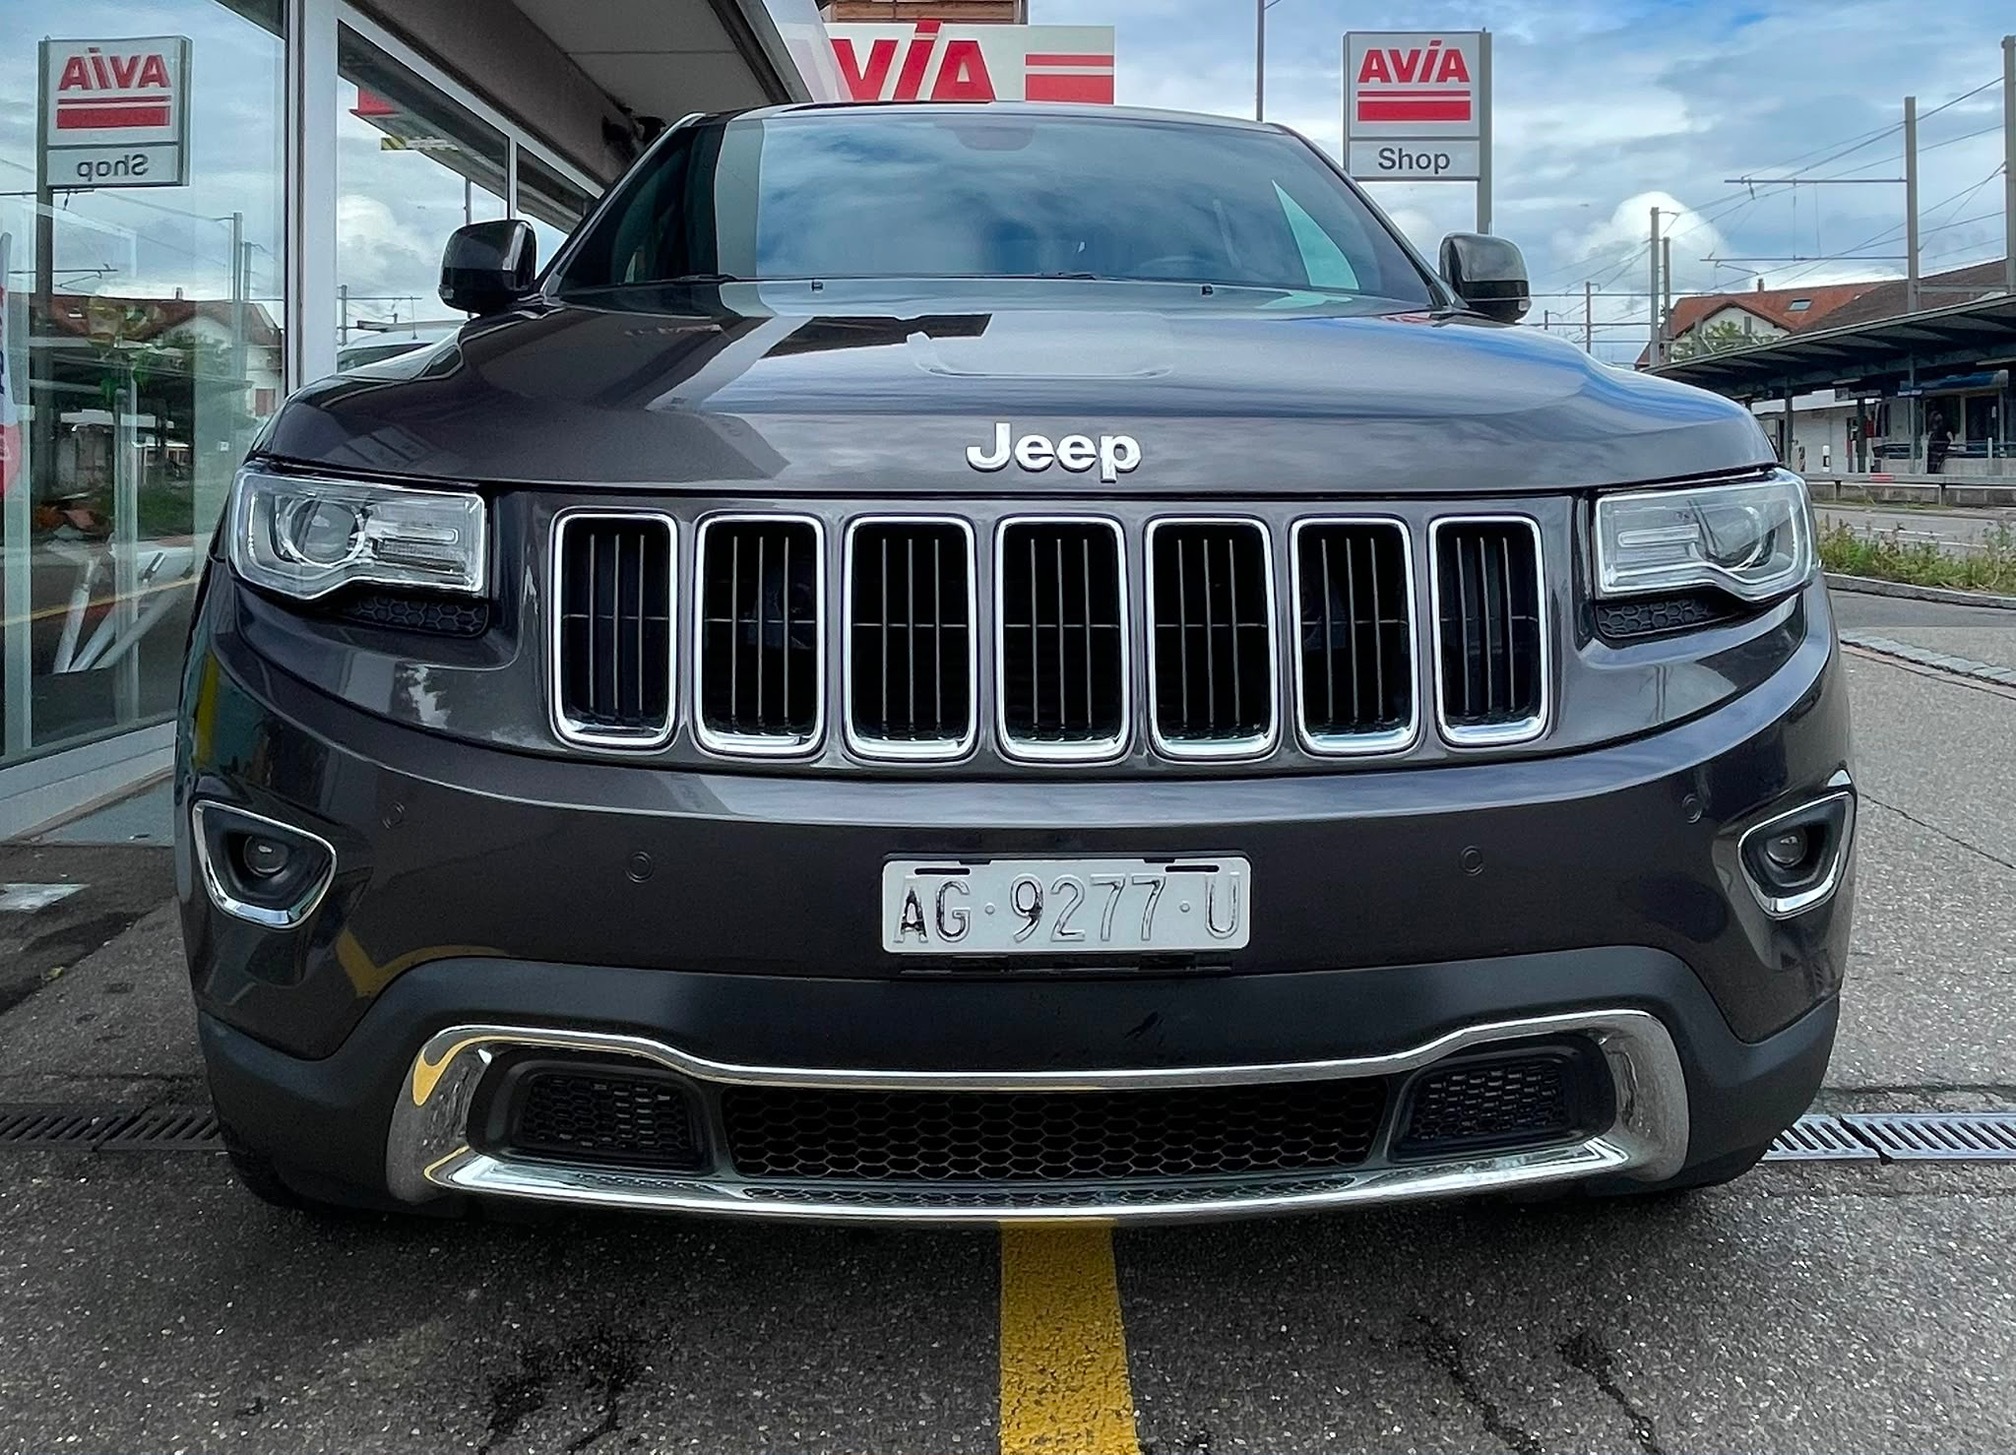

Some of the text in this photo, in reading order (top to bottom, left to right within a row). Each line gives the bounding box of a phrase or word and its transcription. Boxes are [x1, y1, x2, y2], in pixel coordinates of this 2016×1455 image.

[1378, 147, 1450, 174] Shop
[966, 422, 1142, 483] Jeep
[893, 872, 1241, 943] AG 9277 U
